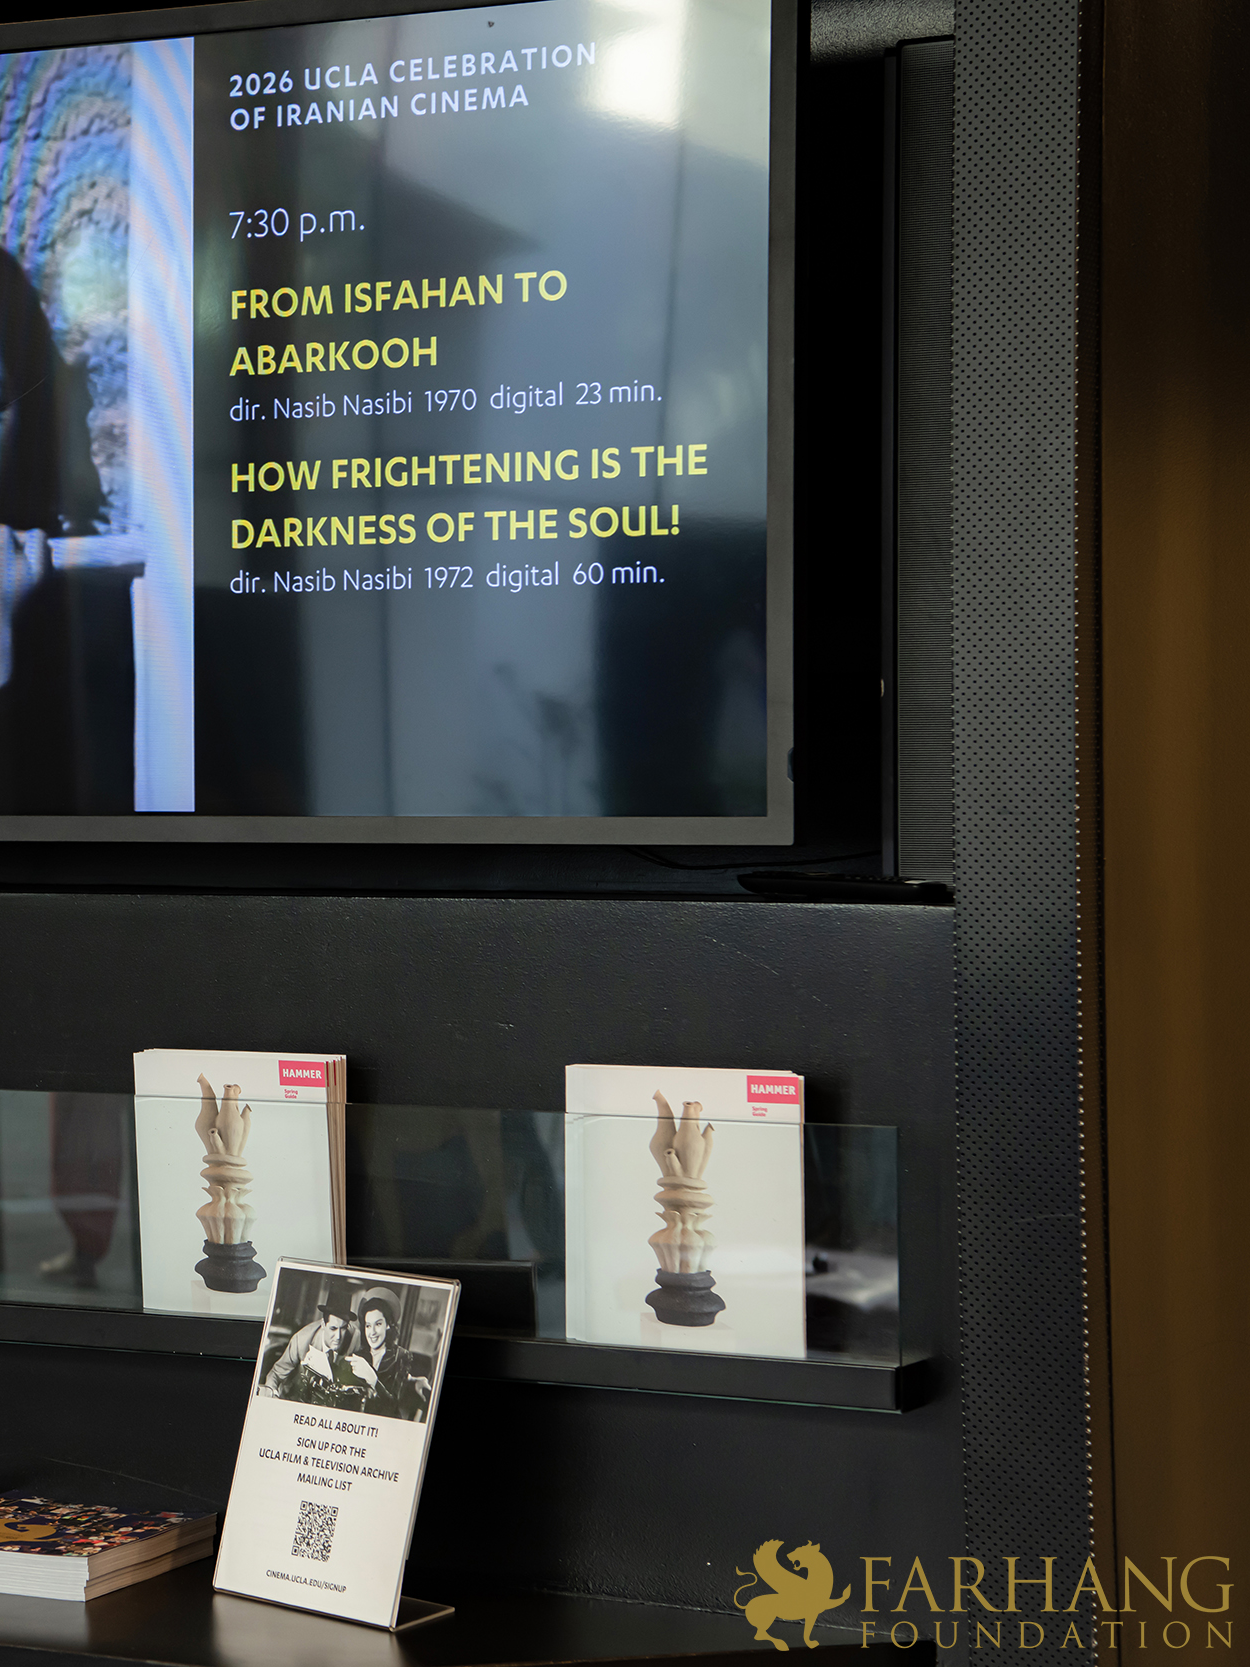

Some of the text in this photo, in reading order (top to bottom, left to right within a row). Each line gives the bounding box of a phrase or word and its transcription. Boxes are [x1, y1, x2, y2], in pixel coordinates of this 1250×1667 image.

[229, 42, 596, 98] 2026 UCLA CELEBRATION
[230, 84, 529, 131] OF IRANIAN CINEMA
[229, 207, 366, 242] 7:30 p.m.
[231, 269, 568, 321] FROM ISFAHAN TO
[229, 336, 439, 377] ABARKOOH
[229, 379, 662, 422] dir. Nasib Nasibi 1970 digital 23 min.
[231, 444, 708, 493] HOW FRIGHTENING IS THE
[231, 504, 681, 549] DARKNESS OF THE SOUL!
[229, 560, 665, 594] dir. Nasib Nasibi 1972 digital 60 min.
[282, 1068, 322, 1079] HAMMER
[751, 1084, 796, 1095] HAMMER
[293, 1414, 379, 1438] READ ALL ABOUT IT!
[296, 1437, 367, 1458] SIGN UP FOR THE
[259, 1448, 399, 1482] UCLA FILM & TELEVISION ARCHIVE
[297, 1473, 352, 1491] MAILING LIST
[266, 1569, 347, 1593] CINEMA.UCLA.EDU/SIGNUP
